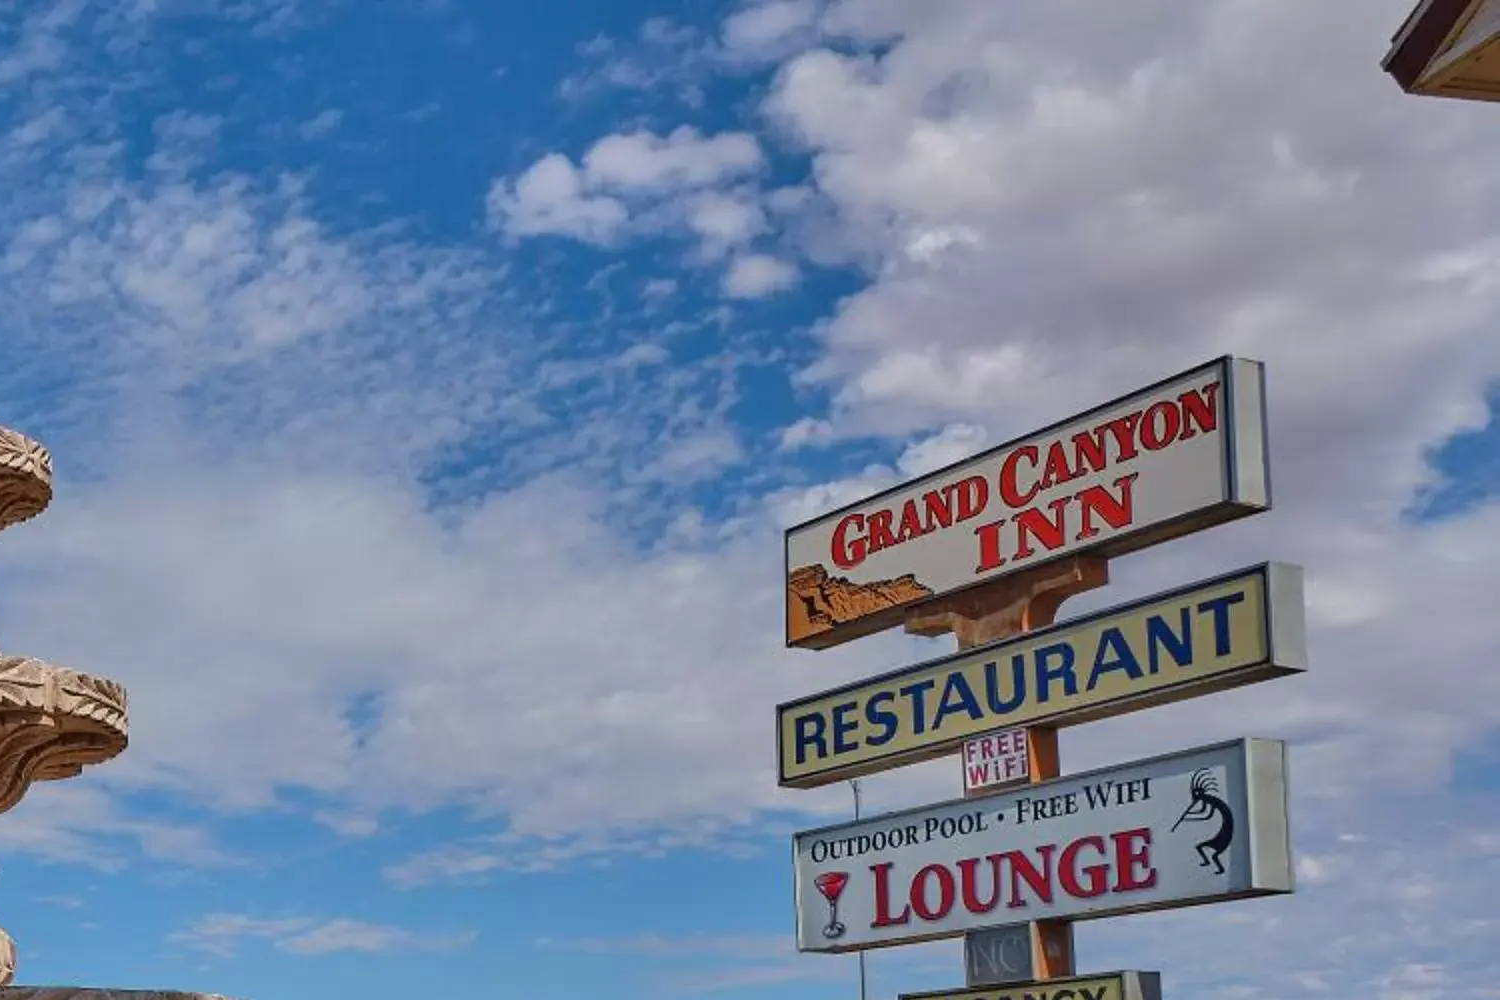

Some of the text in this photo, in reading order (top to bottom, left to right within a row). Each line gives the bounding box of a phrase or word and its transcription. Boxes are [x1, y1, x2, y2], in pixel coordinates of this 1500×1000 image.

[830, 380, 1221, 570] GRAND CANYON
[973, 471, 1138, 574] INN
[794, 591, 1245, 765] RESTAURANT
[967, 731, 1024, 763] FREE
[810, 824, 918, 864] OUTDOOR
[923, 810, 989, 842] POOL
[1015, 795, 1079, 825] FREE
[868, 826, 1157, 929] LOUNGE
